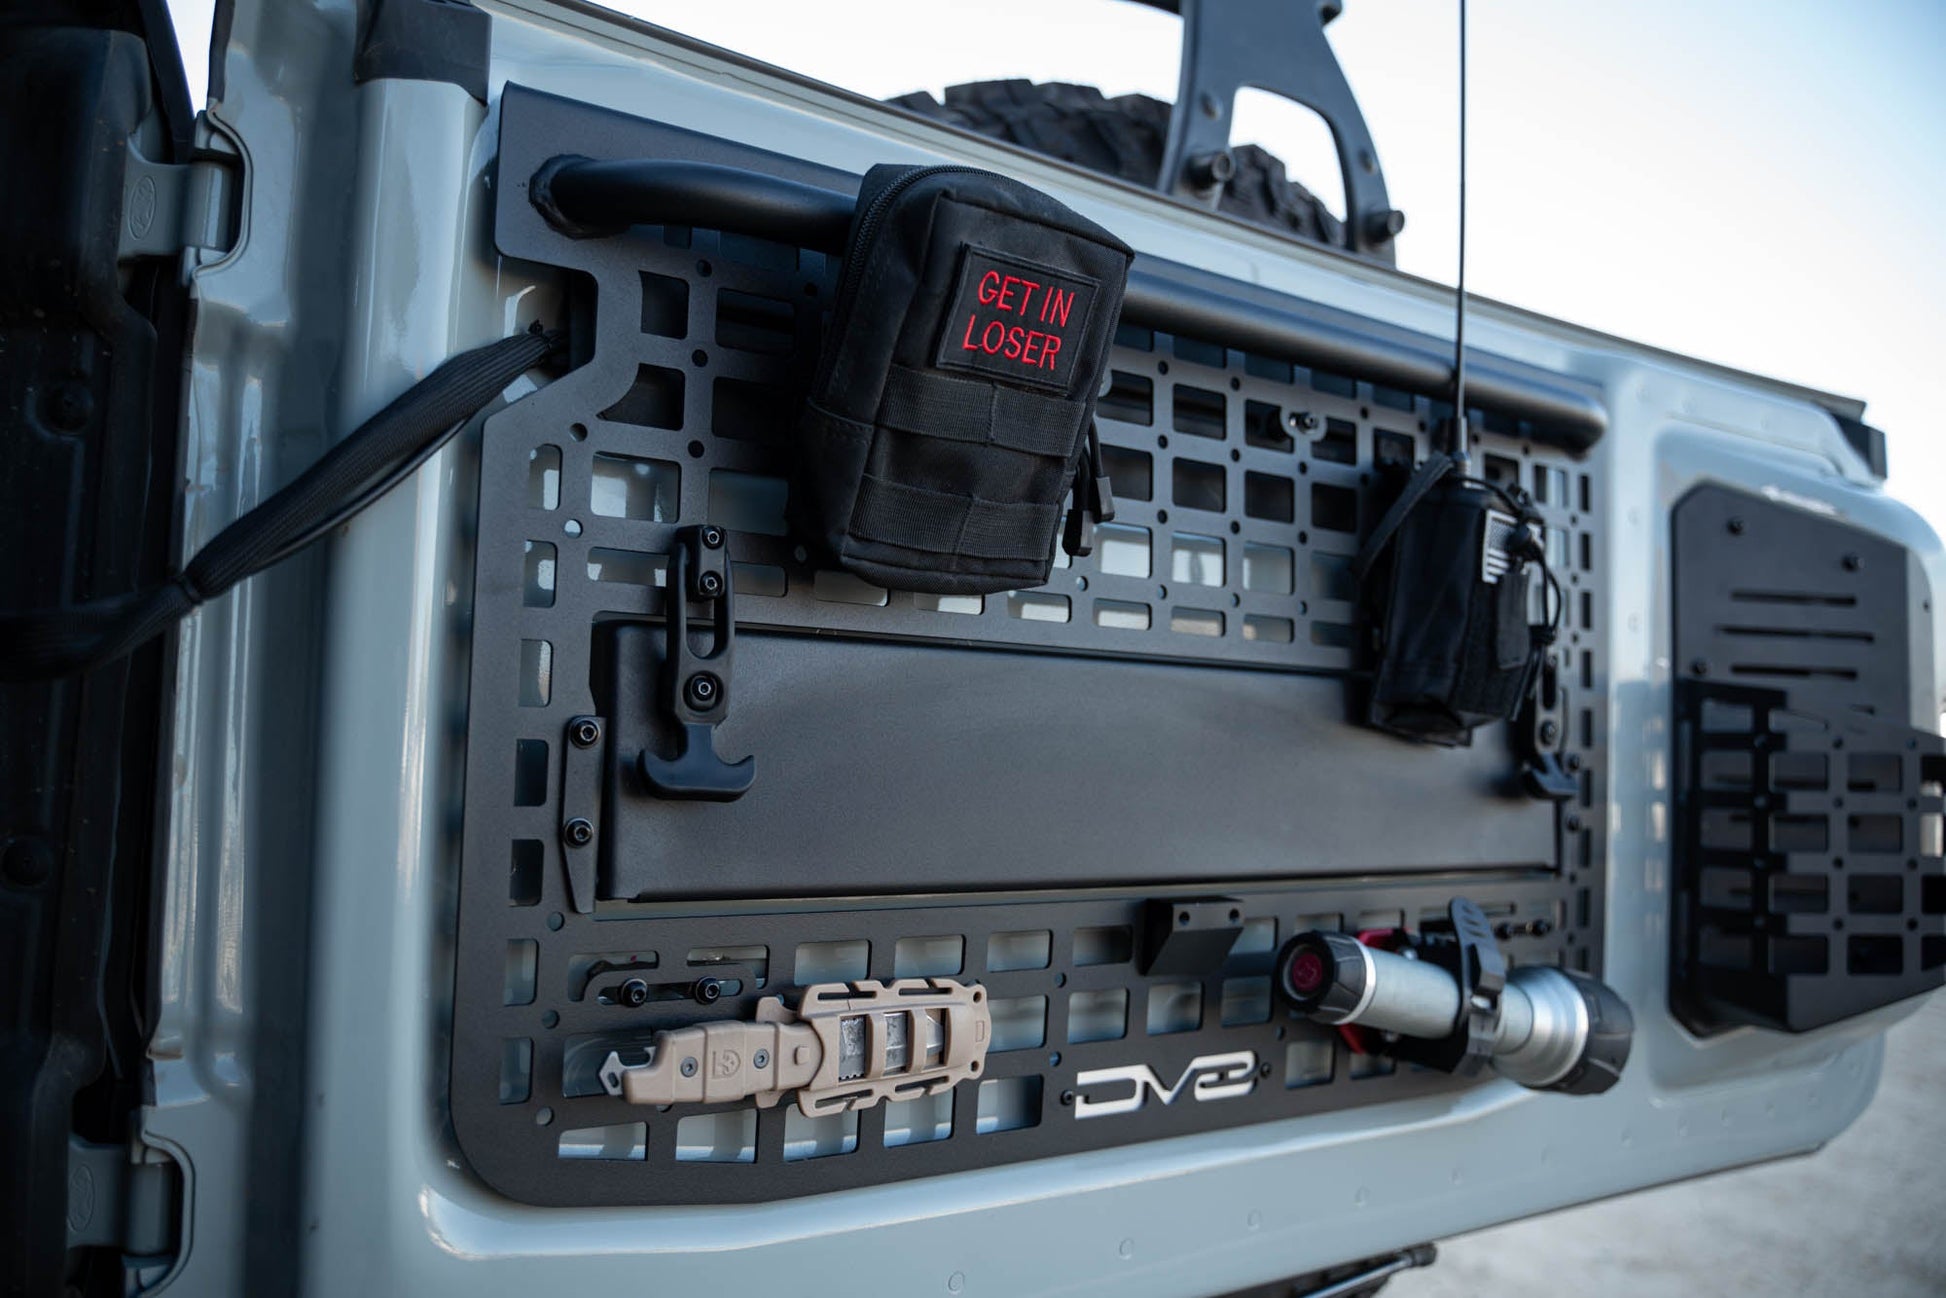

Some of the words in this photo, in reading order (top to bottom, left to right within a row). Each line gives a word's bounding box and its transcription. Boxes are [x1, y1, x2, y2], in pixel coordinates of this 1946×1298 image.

[978, 270, 1040, 316] GET
[1039, 286, 1075, 328] IN
[962, 314, 1062, 370] LOSER
